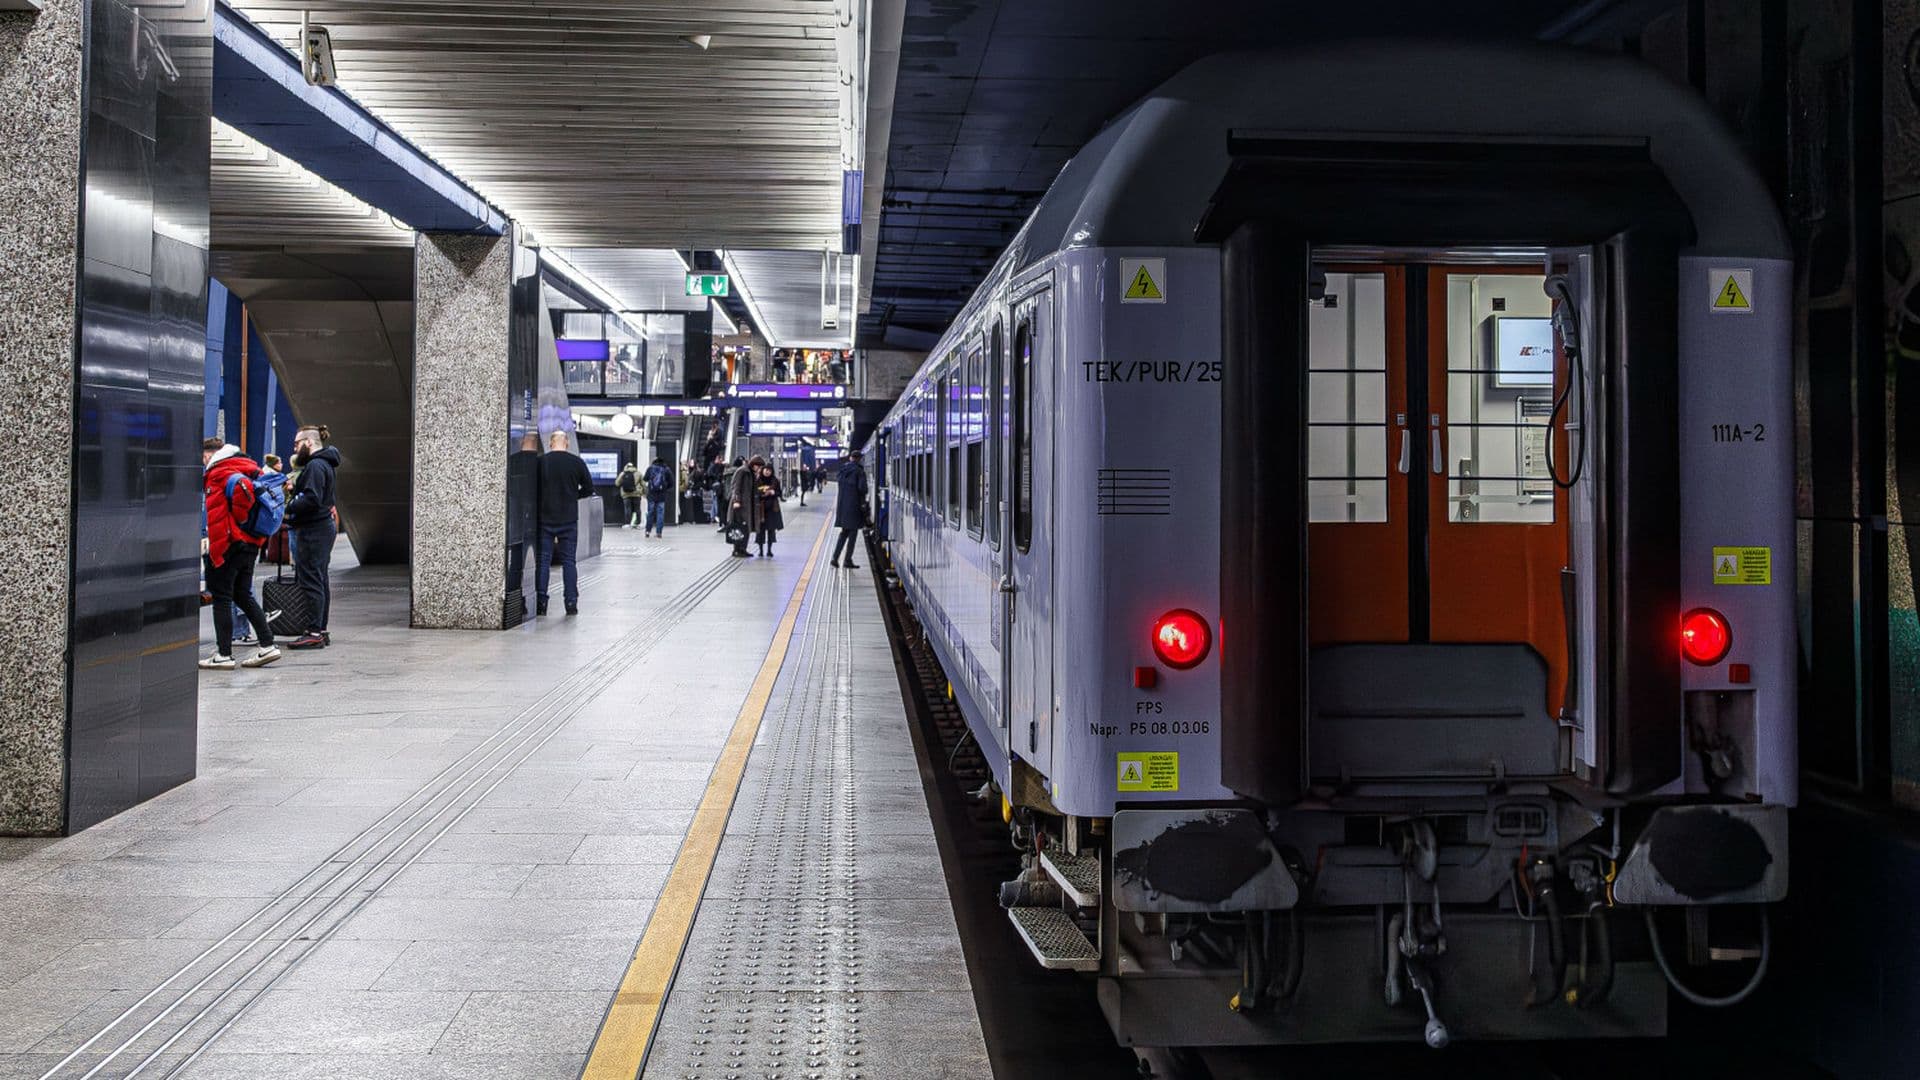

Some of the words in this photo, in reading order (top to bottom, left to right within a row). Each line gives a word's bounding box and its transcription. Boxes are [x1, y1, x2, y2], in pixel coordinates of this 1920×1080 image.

[1082, 361, 1223, 382] TEK/PUR/25
[727, 385, 738, 397] 4
[834, 386, 844, 398] 8
[1712, 423, 1765, 442] 111A-2
[1136, 701, 1163, 714] FPS
[1090, 723, 1122, 738] Napr.
[1130, 722, 1147, 735] P5
